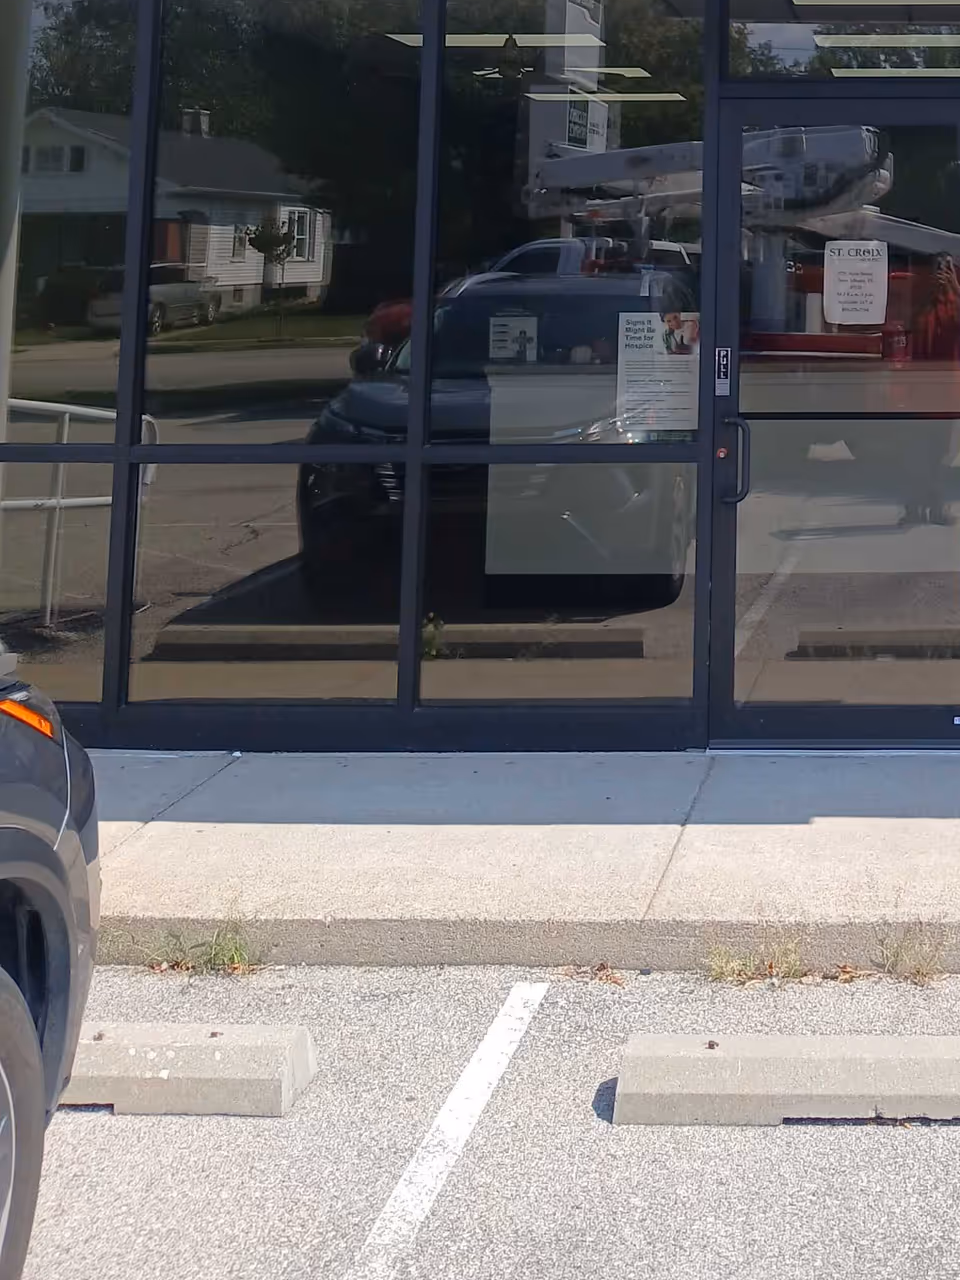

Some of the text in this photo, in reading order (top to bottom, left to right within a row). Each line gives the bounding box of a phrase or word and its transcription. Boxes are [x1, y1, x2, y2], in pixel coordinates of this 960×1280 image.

[829, 247, 883, 257] ST. CROIX
[624, 326, 645, 335] Might
[624, 342, 654, 350] Hospice
[720, 350, 728, 379] PULL
